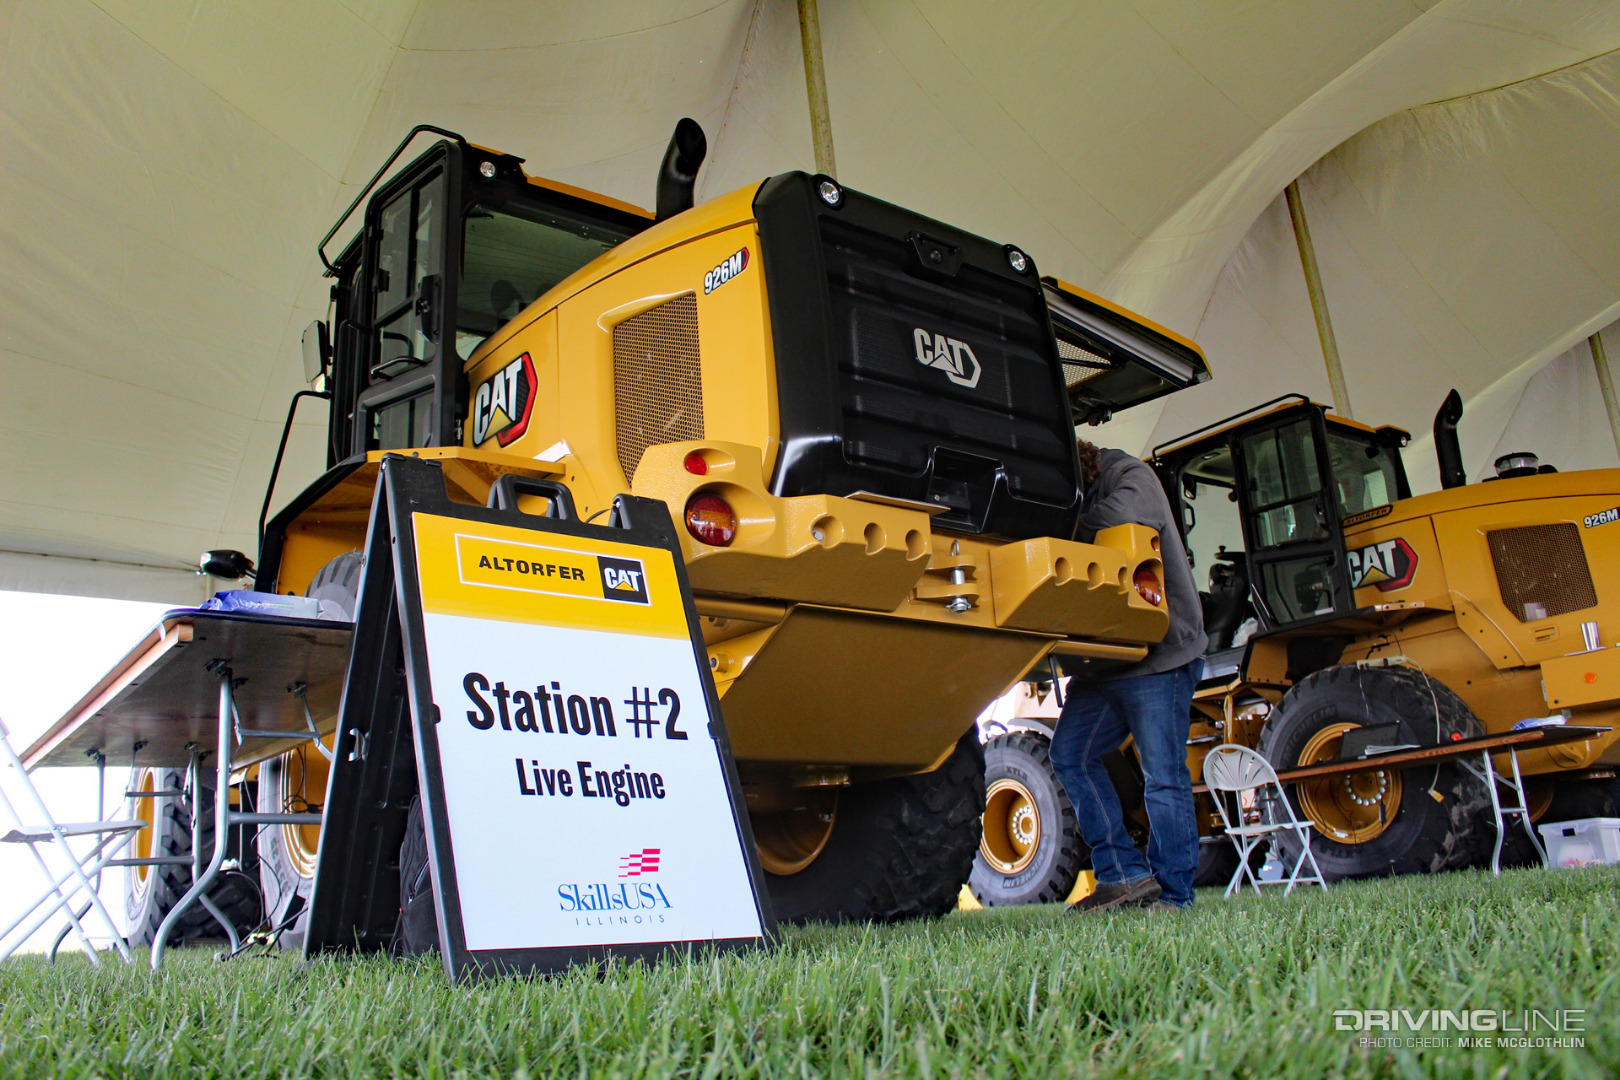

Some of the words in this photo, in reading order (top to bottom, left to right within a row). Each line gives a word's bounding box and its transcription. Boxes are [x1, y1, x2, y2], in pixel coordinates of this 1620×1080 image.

[704, 250, 743, 295] 926M
[914, 327, 965, 376] CAT
[473, 356, 523, 445] CAT
[1584, 508, 1619, 528] 926M
[478, 555, 585, 581] ALTORFER
[604, 567, 640, 592] CAT
[1347, 540, 1397, 589] CAT
[463, 672, 617, 737] Station
[624, 686, 689, 740] #2
[515, 758, 574, 797] Live
[577, 760, 666, 807] Engine
[557, 882, 674, 912] SkillsUSA
[575, 914, 665, 926] ILLINOIS
